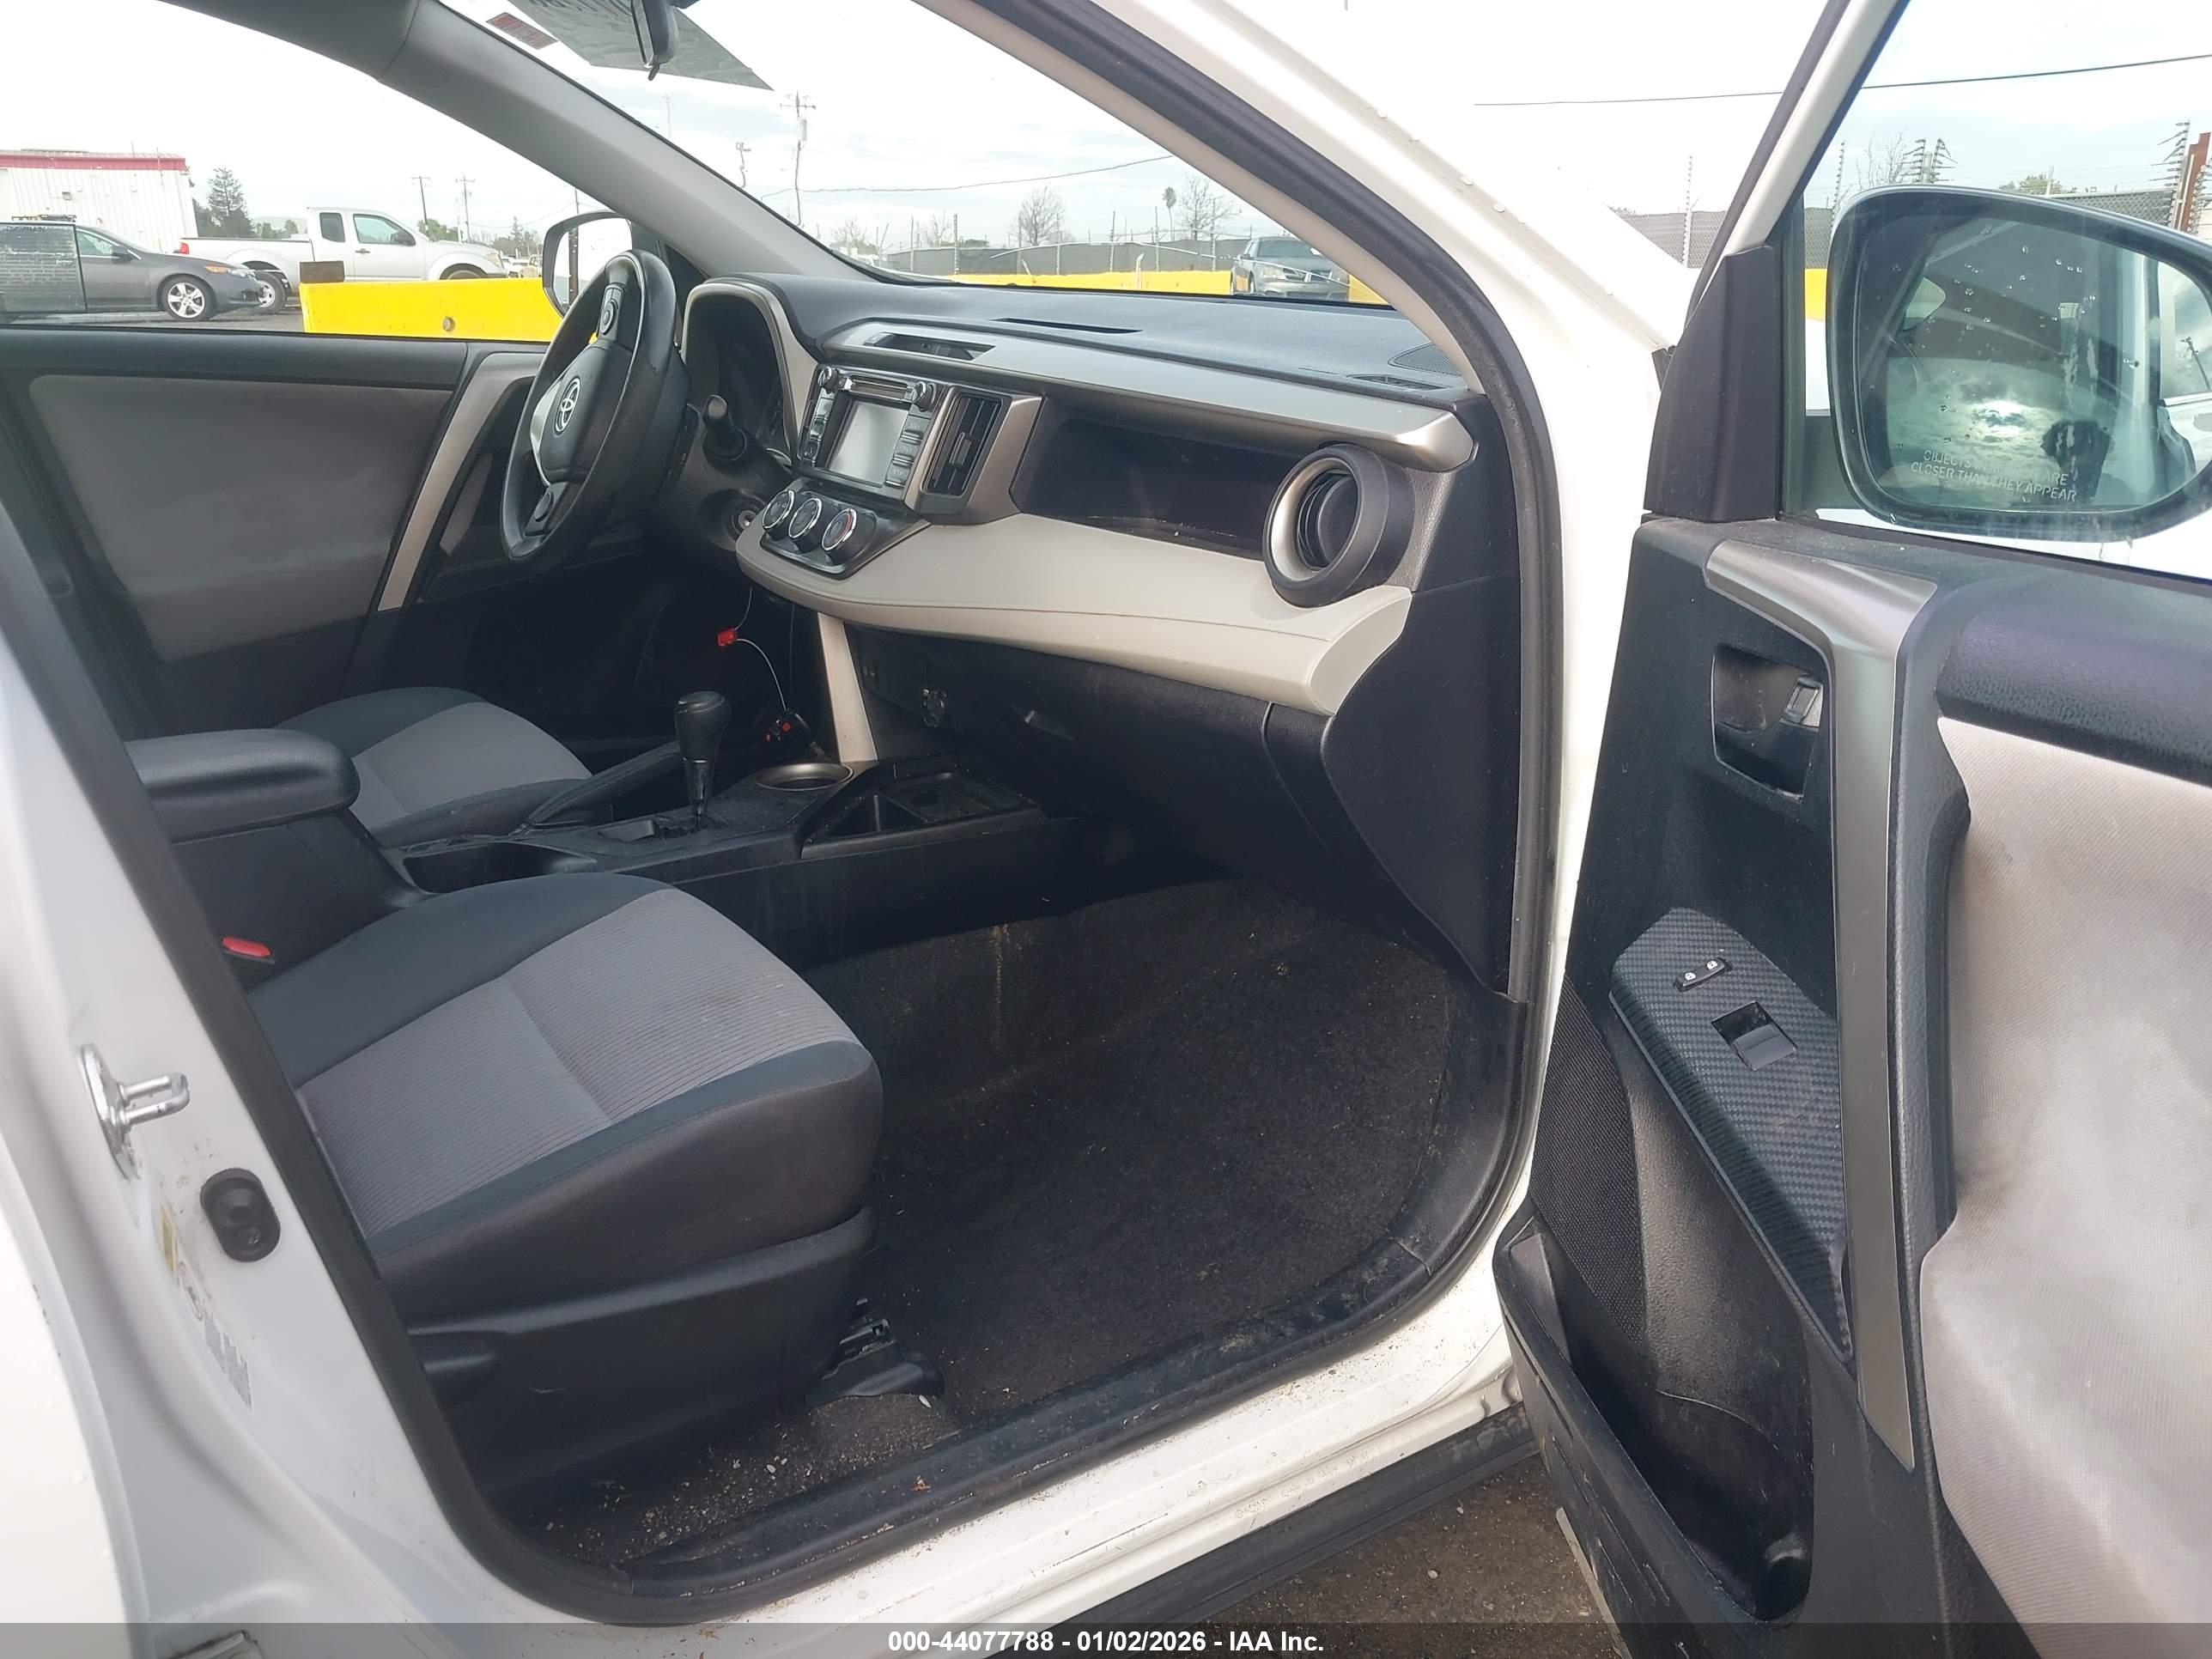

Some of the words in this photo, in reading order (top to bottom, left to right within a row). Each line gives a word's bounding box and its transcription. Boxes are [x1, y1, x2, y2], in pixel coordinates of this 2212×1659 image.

[1923, 450, 1972, 469] OBJECTS
[1911, 461, 1955, 479] CLOSER
[2025, 482, 2077, 502] APPEAR
